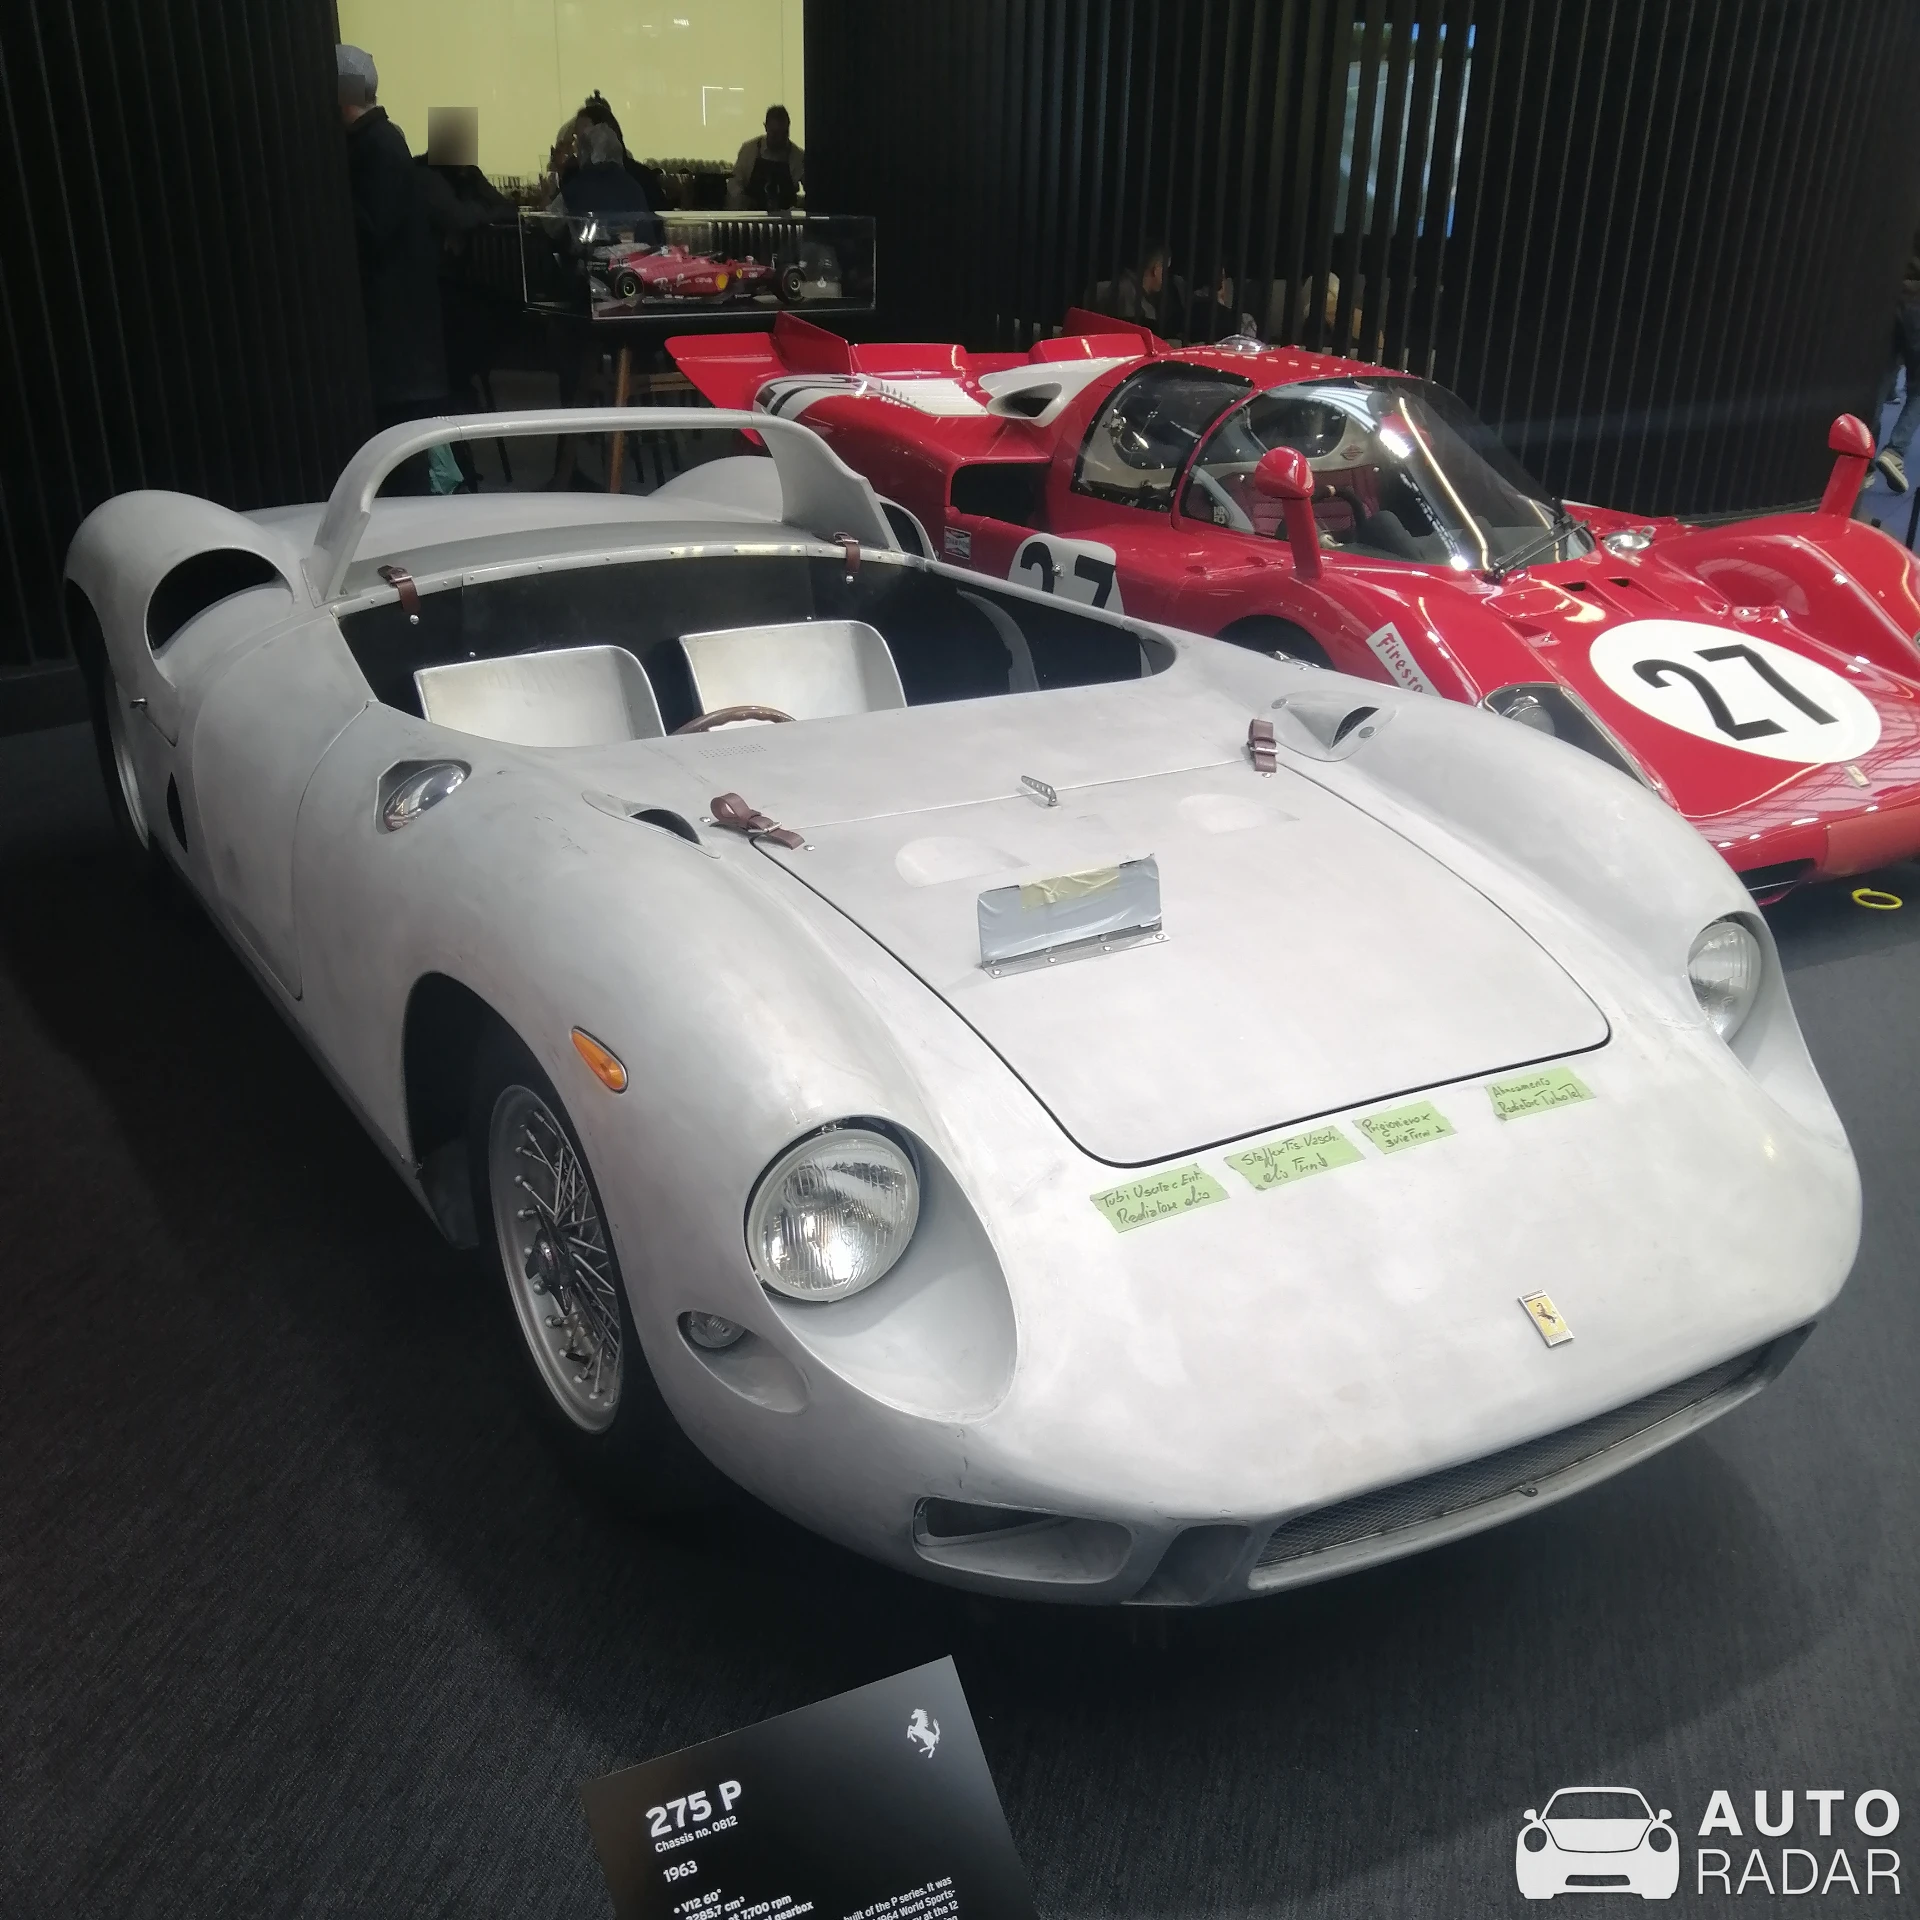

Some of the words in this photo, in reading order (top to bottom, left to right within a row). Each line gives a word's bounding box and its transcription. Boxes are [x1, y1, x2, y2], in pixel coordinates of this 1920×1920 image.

[1632, 644, 1839, 741] 27
[645, 1790, 712, 1837] 275
[719, 1780, 742, 1811] P
[655, 1832, 694, 1853] Chassis
[695, 1827, 712, 1839] no.
[712, 1815, 739, 1832] 0812
[663, 1860, 698, 1883] 1963
[681, 1897, 703, 1912] V12
[771, 1895, 792, 1909] rpm
[865, 1905, 875, 1917] of
[875, 1901, 891, 1913] the
[890, 1896, 898, 1907] P
[899, 1887, 928, 1904] series.
[926, 1881, 936, 1893] It
[934, 1876, 953, 1889] was
[899, 1899, 925, 1917] World
[924, 1888, 956, 1907] Sports-
[933, 1906, 949, 1917] the
[948, 1900, 960, 1911] 12
